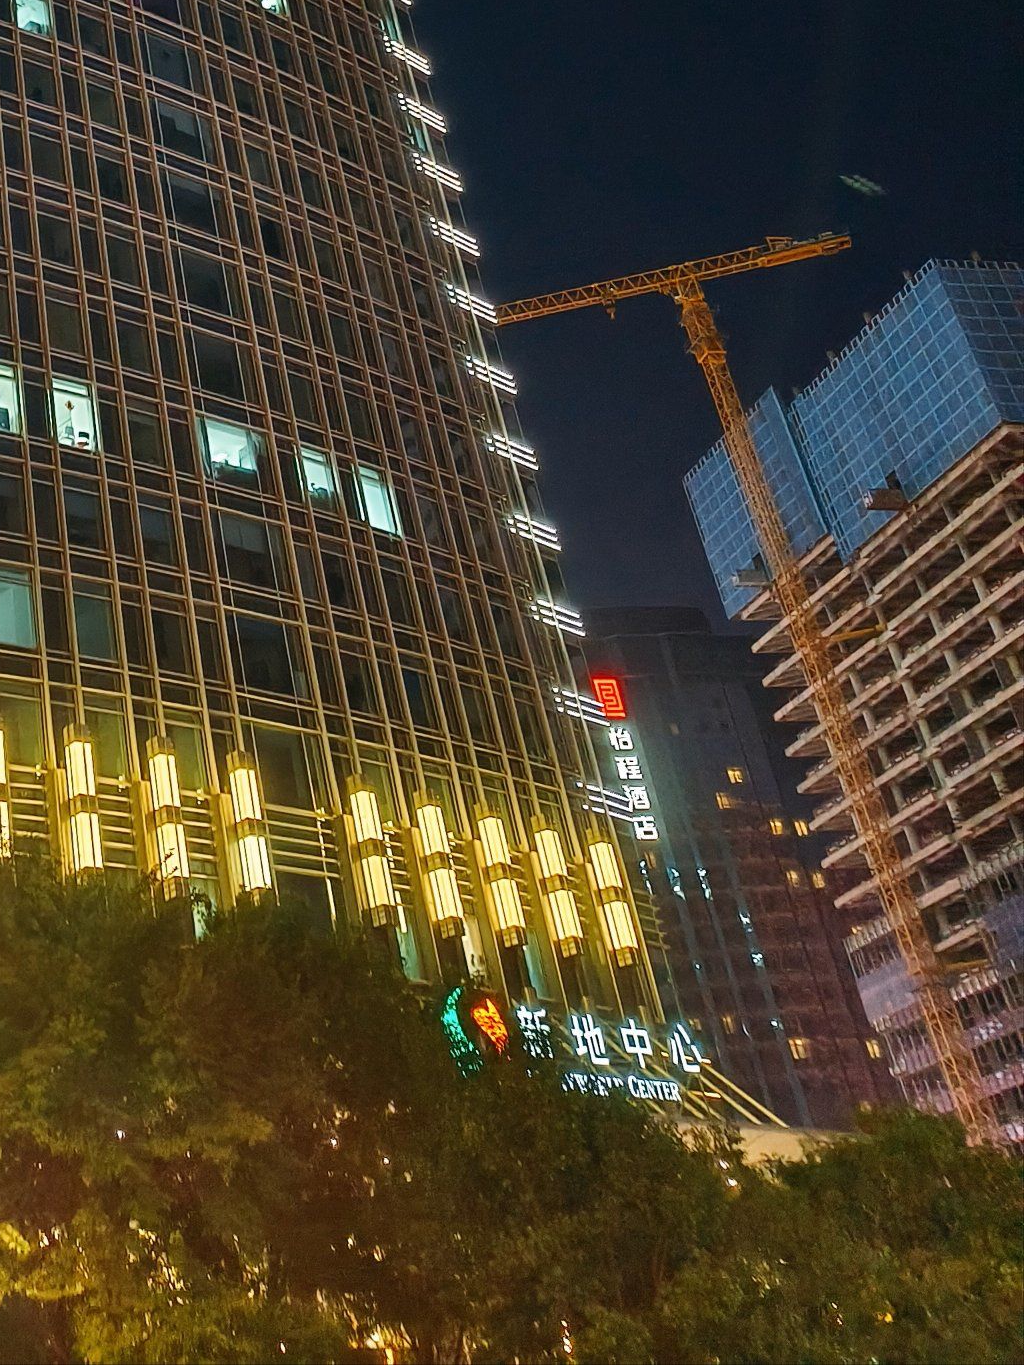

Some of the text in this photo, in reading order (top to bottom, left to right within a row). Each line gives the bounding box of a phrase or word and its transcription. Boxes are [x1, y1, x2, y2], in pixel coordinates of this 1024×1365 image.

[608, 726, 659, 841] 怡程酒店
[516, 1005, 702, 1074] 新地中心
[627, 1074, 683, 1102] CENTER
